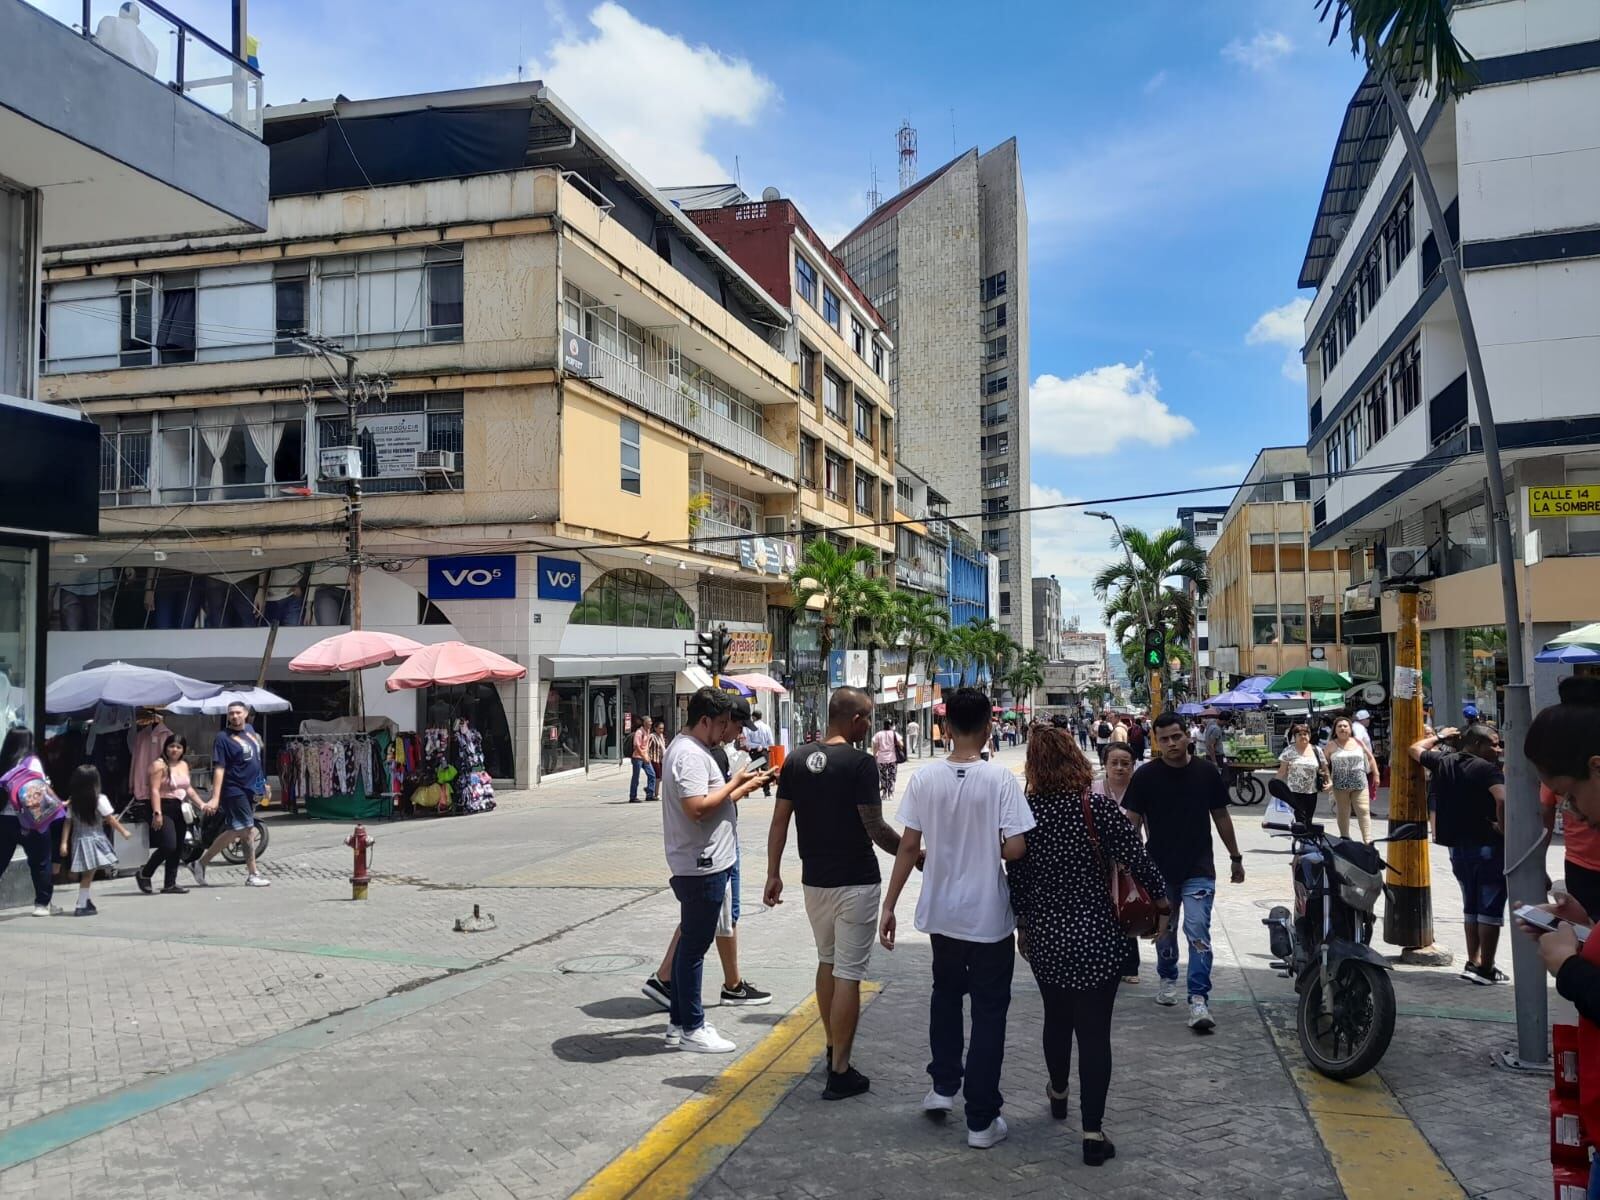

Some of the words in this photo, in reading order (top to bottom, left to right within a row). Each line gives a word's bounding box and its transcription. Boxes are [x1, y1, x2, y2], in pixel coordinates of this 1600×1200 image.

[1533, 490, 1572, 500] CALLE
[1577, 489, 1589, 499] 14
[1533, 502, 1550, 513] LA
[1555, 501, 1600, 512] SOMBRE
[442, 569, 502, 587] VO5
[546, 570, 576, 588] VO5
